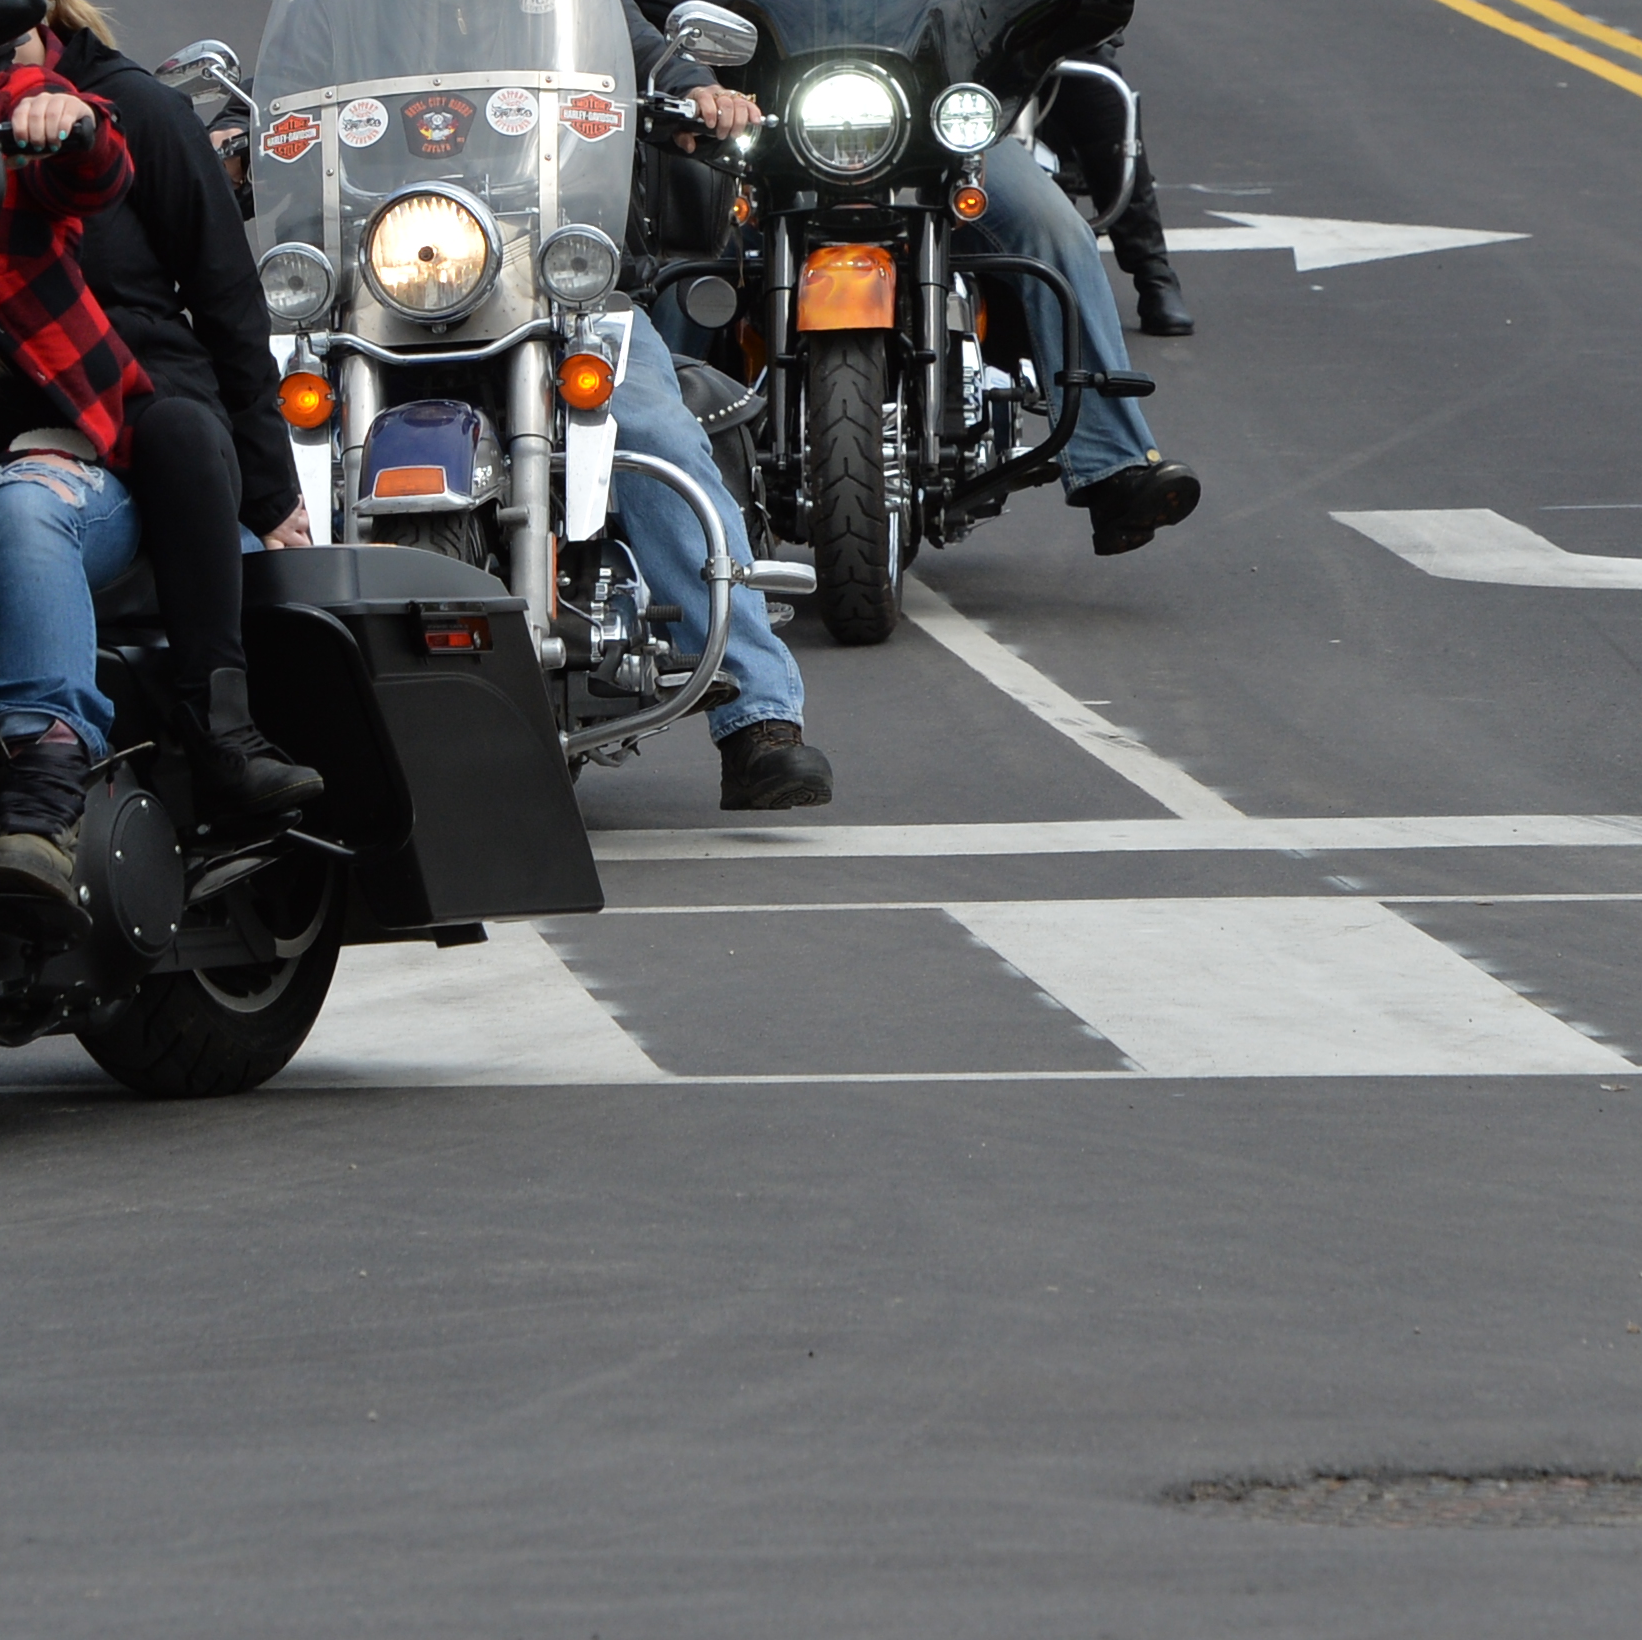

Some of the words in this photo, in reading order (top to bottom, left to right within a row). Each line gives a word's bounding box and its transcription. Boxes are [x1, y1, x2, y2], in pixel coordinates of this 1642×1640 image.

[428, 96, 447, 108] CITY
[498, 90, 529, 103] SUPPORT
[348, 100, 379, 114] SUPPORT
[494, 119, 532, 134] KITCHENER
[344, 128, 380, 145] KITCHENER
